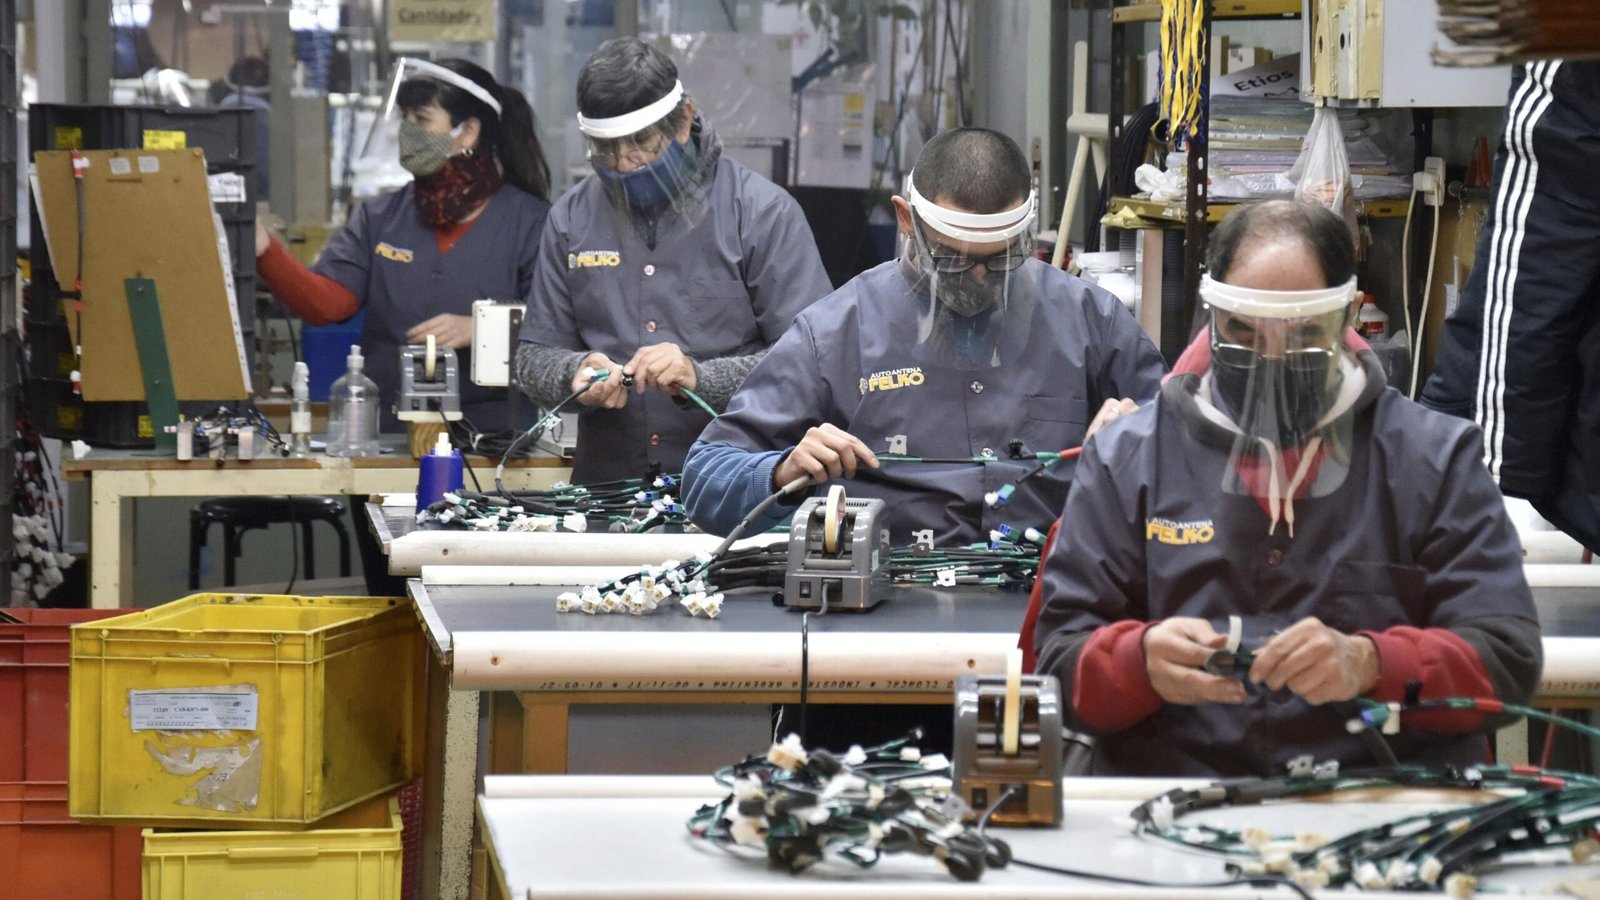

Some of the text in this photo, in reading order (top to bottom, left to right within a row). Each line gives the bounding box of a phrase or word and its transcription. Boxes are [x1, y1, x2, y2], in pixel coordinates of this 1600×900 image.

[1234, 71, 1294, 91] Etios
[870, 366, 922, 378] AUTOANTENA
[1151, 517, 1214, 529] AUTOANTENA
[713, 681, 783, 689] ARGENTINA
[792, 680, 861, 689] INDUSTRA
